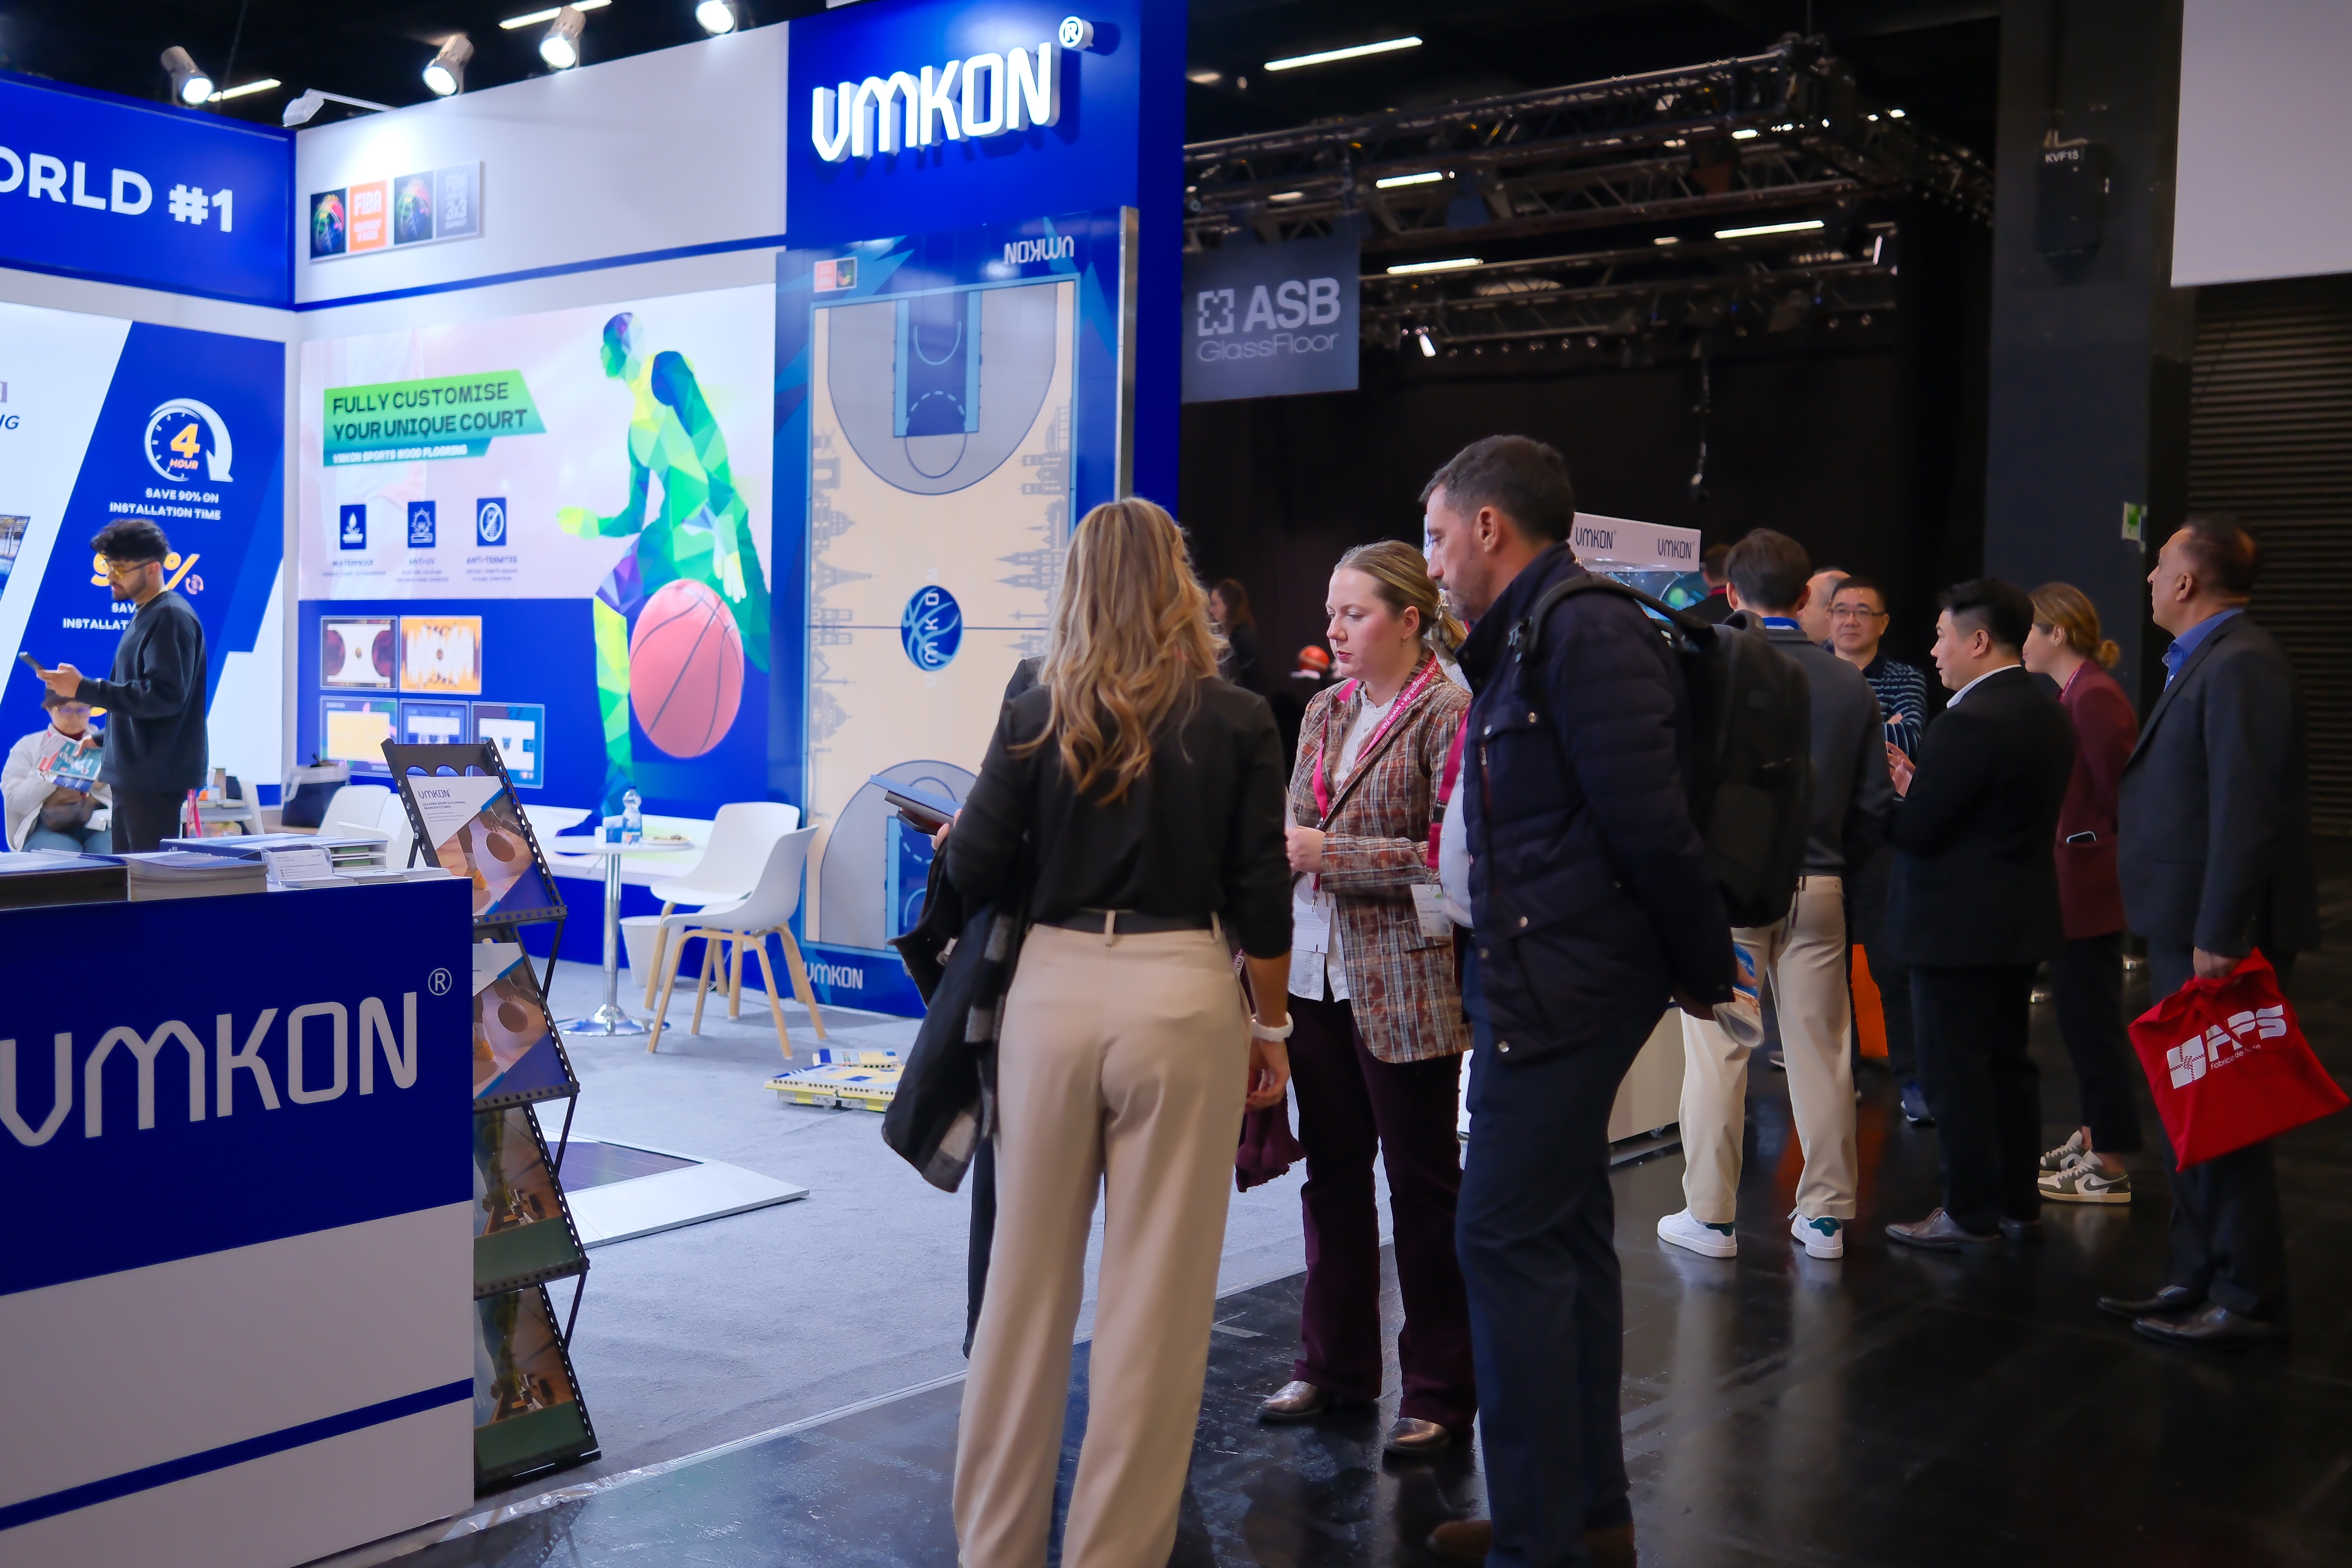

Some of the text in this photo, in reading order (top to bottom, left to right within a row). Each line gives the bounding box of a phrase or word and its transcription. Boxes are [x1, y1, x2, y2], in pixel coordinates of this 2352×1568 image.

[168, 183, 233, 233] #1
[353, 190, 382, 216] FIBA
[1242, 276, 1341, 333] ASB
[1197, 333, 1340, 362] GlassFloor
[333, 381, 509, 415] FULLY CUSTOMISE
[332, 409, 528, 441] YOUR UNIQUE COURT
[170, 423, 200, 458] 4
[170, 458, 198, 470] HOUR
[362, 449, 396, 461] SPORTS
[145, 488, 219, 504] SAVE 90% ON
[109, 502, 221, 521] INSTALLATION TIME
[111, 602, 138, 614] SAV
[63, 617, 130, 630] INSTALLAT
[2211, 1056, 2234, 1070] Fabrica
